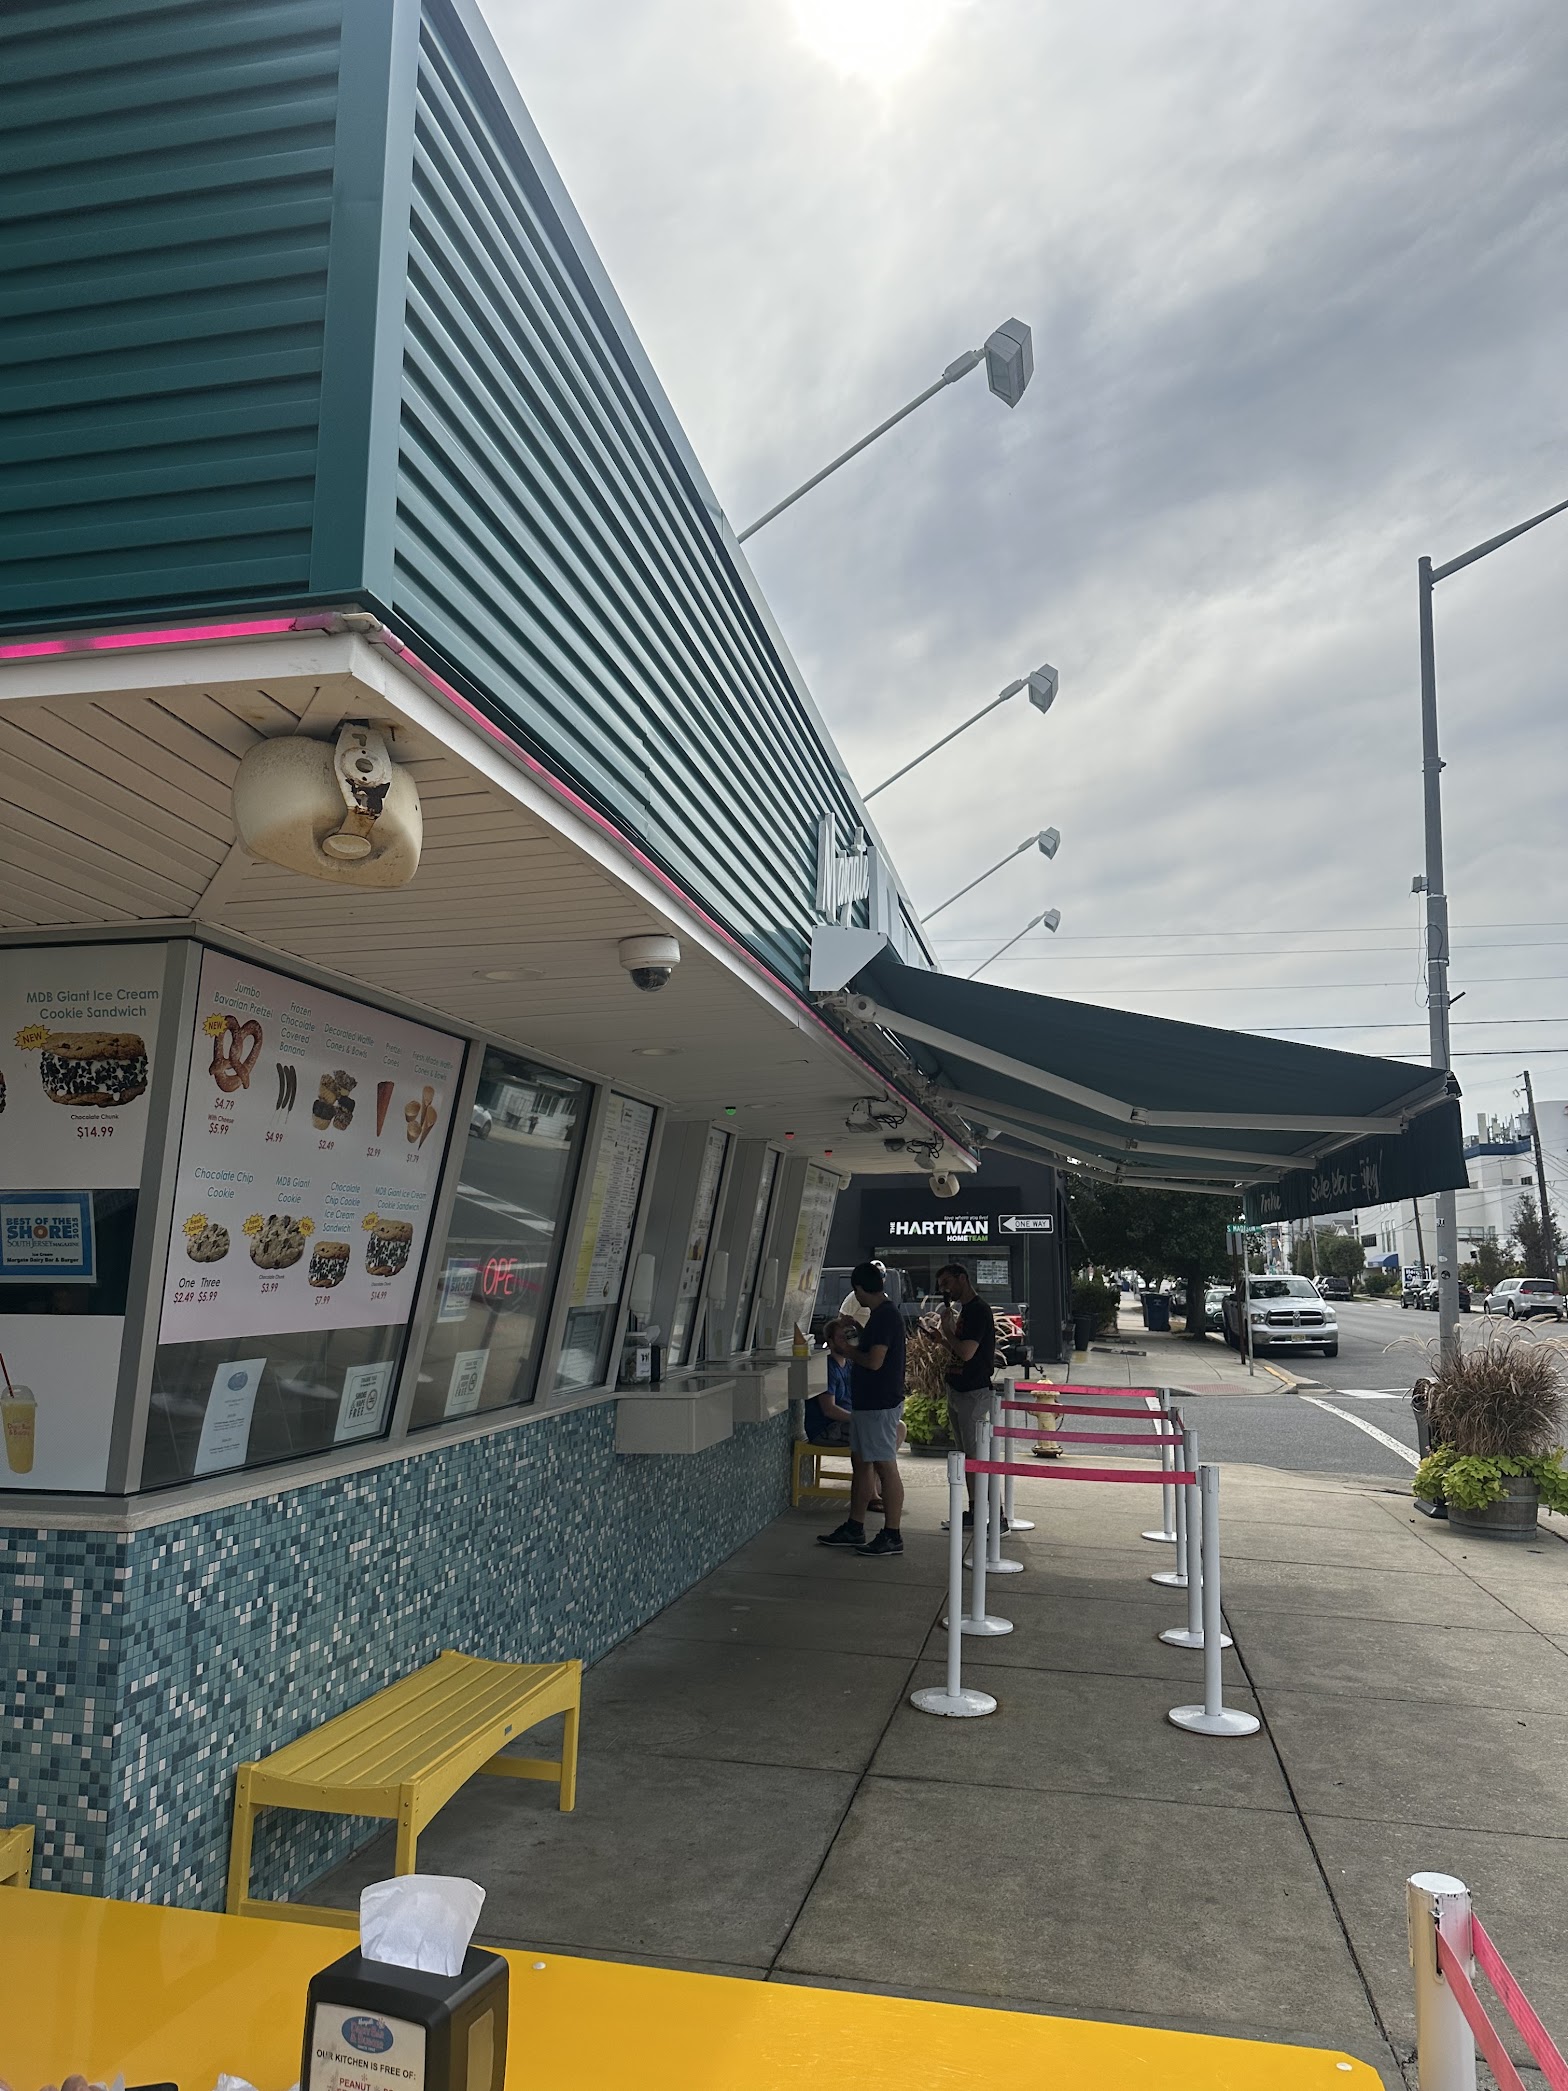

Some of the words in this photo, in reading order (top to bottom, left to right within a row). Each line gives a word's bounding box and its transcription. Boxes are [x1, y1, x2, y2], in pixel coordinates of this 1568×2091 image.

[26, 992, 53, 1003] MDB
[57, 990, 89, 1002] Giant
[94, 990, 112, 1001] Ice
[117, 989, 159, 1000] Cream
[235, 982, 261, 998] Jumbo
[214, 992, 248, 1011] Bavarian
[249, 1003, 273, 1018] Pretzel
[290, 1002, 312, 1017] Frozen
[40, 1008, 83, 1019] Cookie
[87, 1006, 146, 1018] Sandwich
[208, 1021, 222, 1030] NEW
[280, 1013, 316, 1032] Chocolate
[22, 1032, 42, 1044] NEW
[281, 1027, 310, 1044] Covered
[324, 1023, 356, 1041] Decorated
[279, 1041, 305, 1056] Banana
[326, 1039, 345, 1052] Cones
[383, 1055, 399, 1067] Cones
[214, 1097, 235, 1110] $4.79
[218, 1115, 235, 1124] Cheese
[77, 1126, 114, 1139] $14.99
[209, 1122, 229, 1135] $5.99
[265, 1131, 284, 1143] $4.99
[318, 1139, 334, 1151] $2.49
[366, 1147, 381, 1158] $2.99
[194, 1167, 235, 1181] Chocolate
[236, 1171, 254, 1184] Chip
[276, 1176, 291, 1187] MDB
[293, 1177, 311, 1188] Giant
[331, 1182, 361, 1193] Chocolate
[207, 1186, 235, 1199] Cookie
[278, 1192, 302, 1204] Cookie
[325, 1195, 339, 1207] Chip
[339, 1196, 361, 1206] Cookie
[377, 1199, 396, 1209] Cookie
[324, 1209, 334, 1219] Ice
[335, 1209, 355, 1219] Cream
[6, 1217, 31, 1225] BEST
[35, 1217, 48, 1225] OF
[52, 1217, 71, 1225] THE
[1015, 1220, 1031, 1228] ONE
[1033, 1220, 1047, 1228] WAY
[7, 1225, 72, 1239] SHORE
[323, 1222, 351, 1233] Sandwich
[896, 1221, 988, 1235] HARTMAN
[7, 1239, 30, 1247] SOUTH
[30, 1238, 53, 1248] JERSEY
[178, 1278, 195, 1288] One
[201, 1277, 221, 1287] Three
[261, 1283, 279, 1294] $3.99
[450, 1281, 473, 1293] SHORE
[173, 1292, 194, 1304] $2.49
[198, 1291, 218, 1303] $5.99
[315, 1295, 330, 1306] $7.99
[370, 1291, 387, 1301] $14.99
[349, 1407, 364, 1419] FREE
[335, 2054, 368, 2069] KITCHEN
[370, 2062, 378, 2071] IS
[380, 2064, 401, 2077] FREE
[402, 2069, 417, 2080] OF:
[339, 2078, 371, 2091] PEANUT
